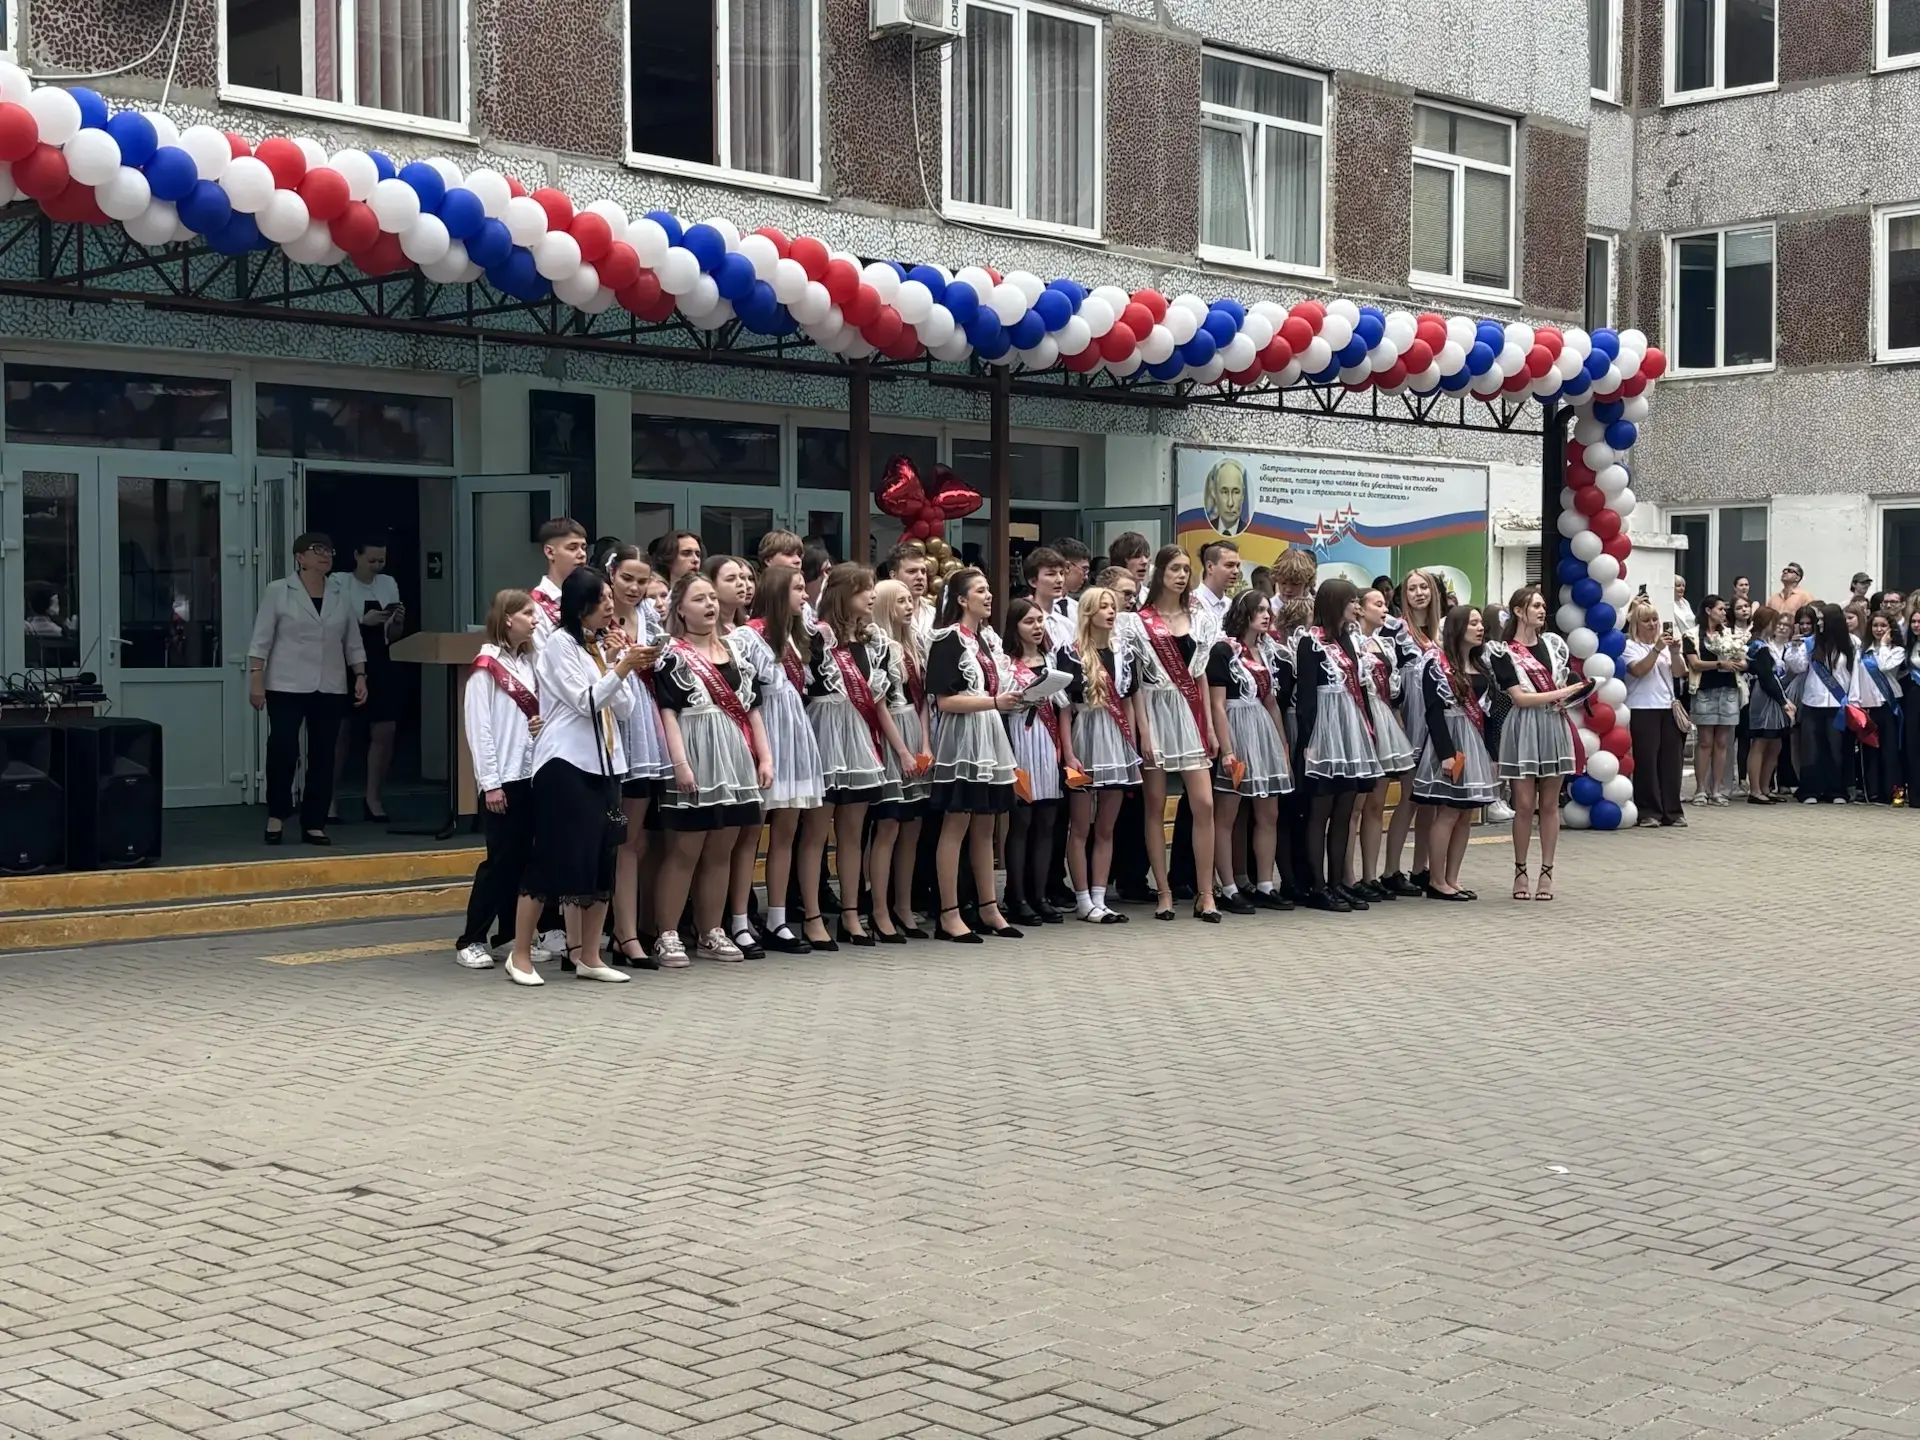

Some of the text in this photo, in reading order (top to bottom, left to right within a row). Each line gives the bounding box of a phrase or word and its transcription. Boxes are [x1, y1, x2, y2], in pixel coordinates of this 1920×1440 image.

[1319, 468, 1356, 477] воспитание
[1357, 469, 1379, 479] должно
[1402, 474, 1425, 482] частью
[1295, 478, 1320, 487] потому
[1360, 480, 1370, 488] без
[1371, 481, 1403, 490] убеждений
[1312, 489, 1352, 497] стремиться
